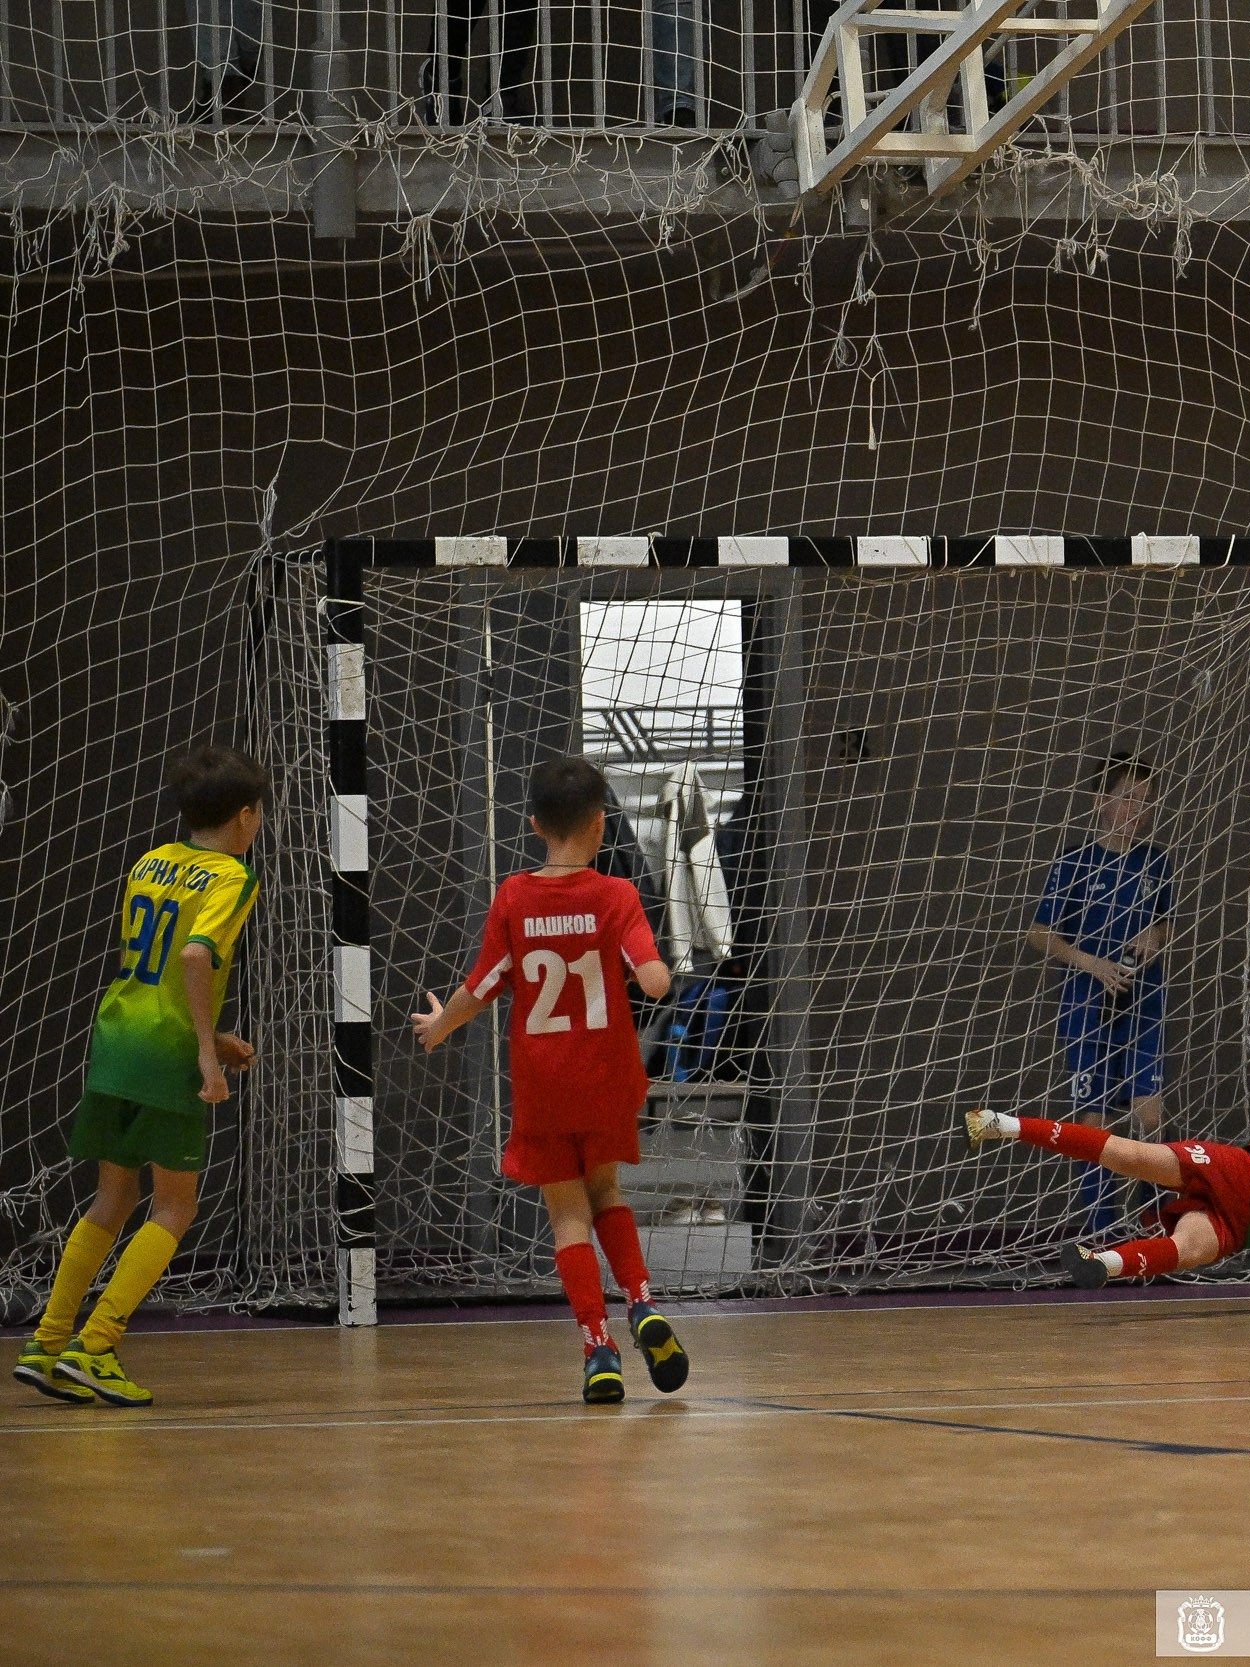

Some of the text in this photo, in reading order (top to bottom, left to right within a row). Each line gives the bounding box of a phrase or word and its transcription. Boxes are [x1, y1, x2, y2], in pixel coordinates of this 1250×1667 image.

[524, 914, 597, 938] ПАШКОВ
[522, 949, 608, 1035] 21
[1070, 1072, 1093, 1099] 13
